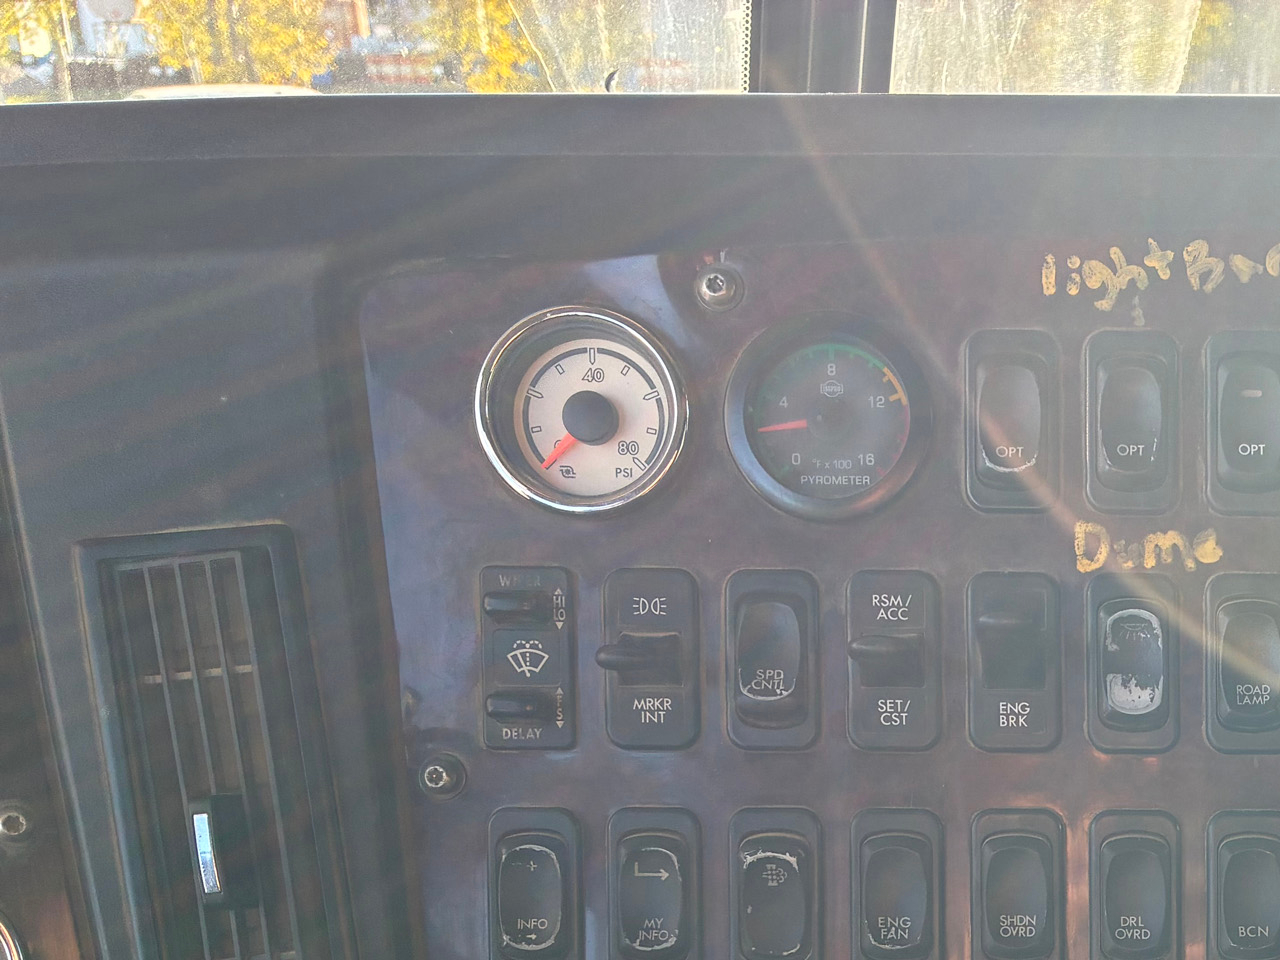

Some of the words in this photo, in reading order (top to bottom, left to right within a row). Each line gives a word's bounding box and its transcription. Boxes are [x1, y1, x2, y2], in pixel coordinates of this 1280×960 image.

[582, 367, 604, 383] 40
[827, 363, 836, 376] 8
[779, 397, 788, 408] 4
[869, 396, 885, 408] 12
[618, 440, 639, 455] 80
[996, 446, 1024, 458] OPT
[1117, 444, 1144, 456] OPT
[1239, 444, 1265, 456] OPT
[791, 453, 800, 465] 0
[833, 460, 852, 469] 100
[858, 453, 875, 466] 16
[615, 467, 633, 478] PSI
[800, 475, 870, 485] PYROMETER
[554, 596, 565, 608] HI
[872, 594, 912, 608] RSM/
[554, 608, 566, 621] LO
[877, 608, 909, 621] ACC
[756, 669, 784, 680] SPD
[752, 679, 784, 690] CNTL
[1236, 684, 1271, 695] ROAD
[633, 698, 672, 711] MRKR
[1237, 695, 1271, 705] LAMP
[999, 702, 1030, 715] ENG
[641, 711, 666, 724] INT
[880, 712, 908, 725] CST
[999, 714, 1028, 727] BRK
[503, 728, 542, 740] DELAY
[517, 919, 548, 930] INFO
[643, 918, 663, 929] MY
[878, 916, 911, 928] ENG
[1000, 915, 1036, 927] SHDN
[1120, 916, 1144, 927] DRL
[638, 930, 669, 941] INFO
[880, 927, 909, 939] FAN
[1000, 926, 1036, 938] OVRD
[1115, 928, 1151, 940] OVRD
[1238, 926, 1269, 937] BCN
